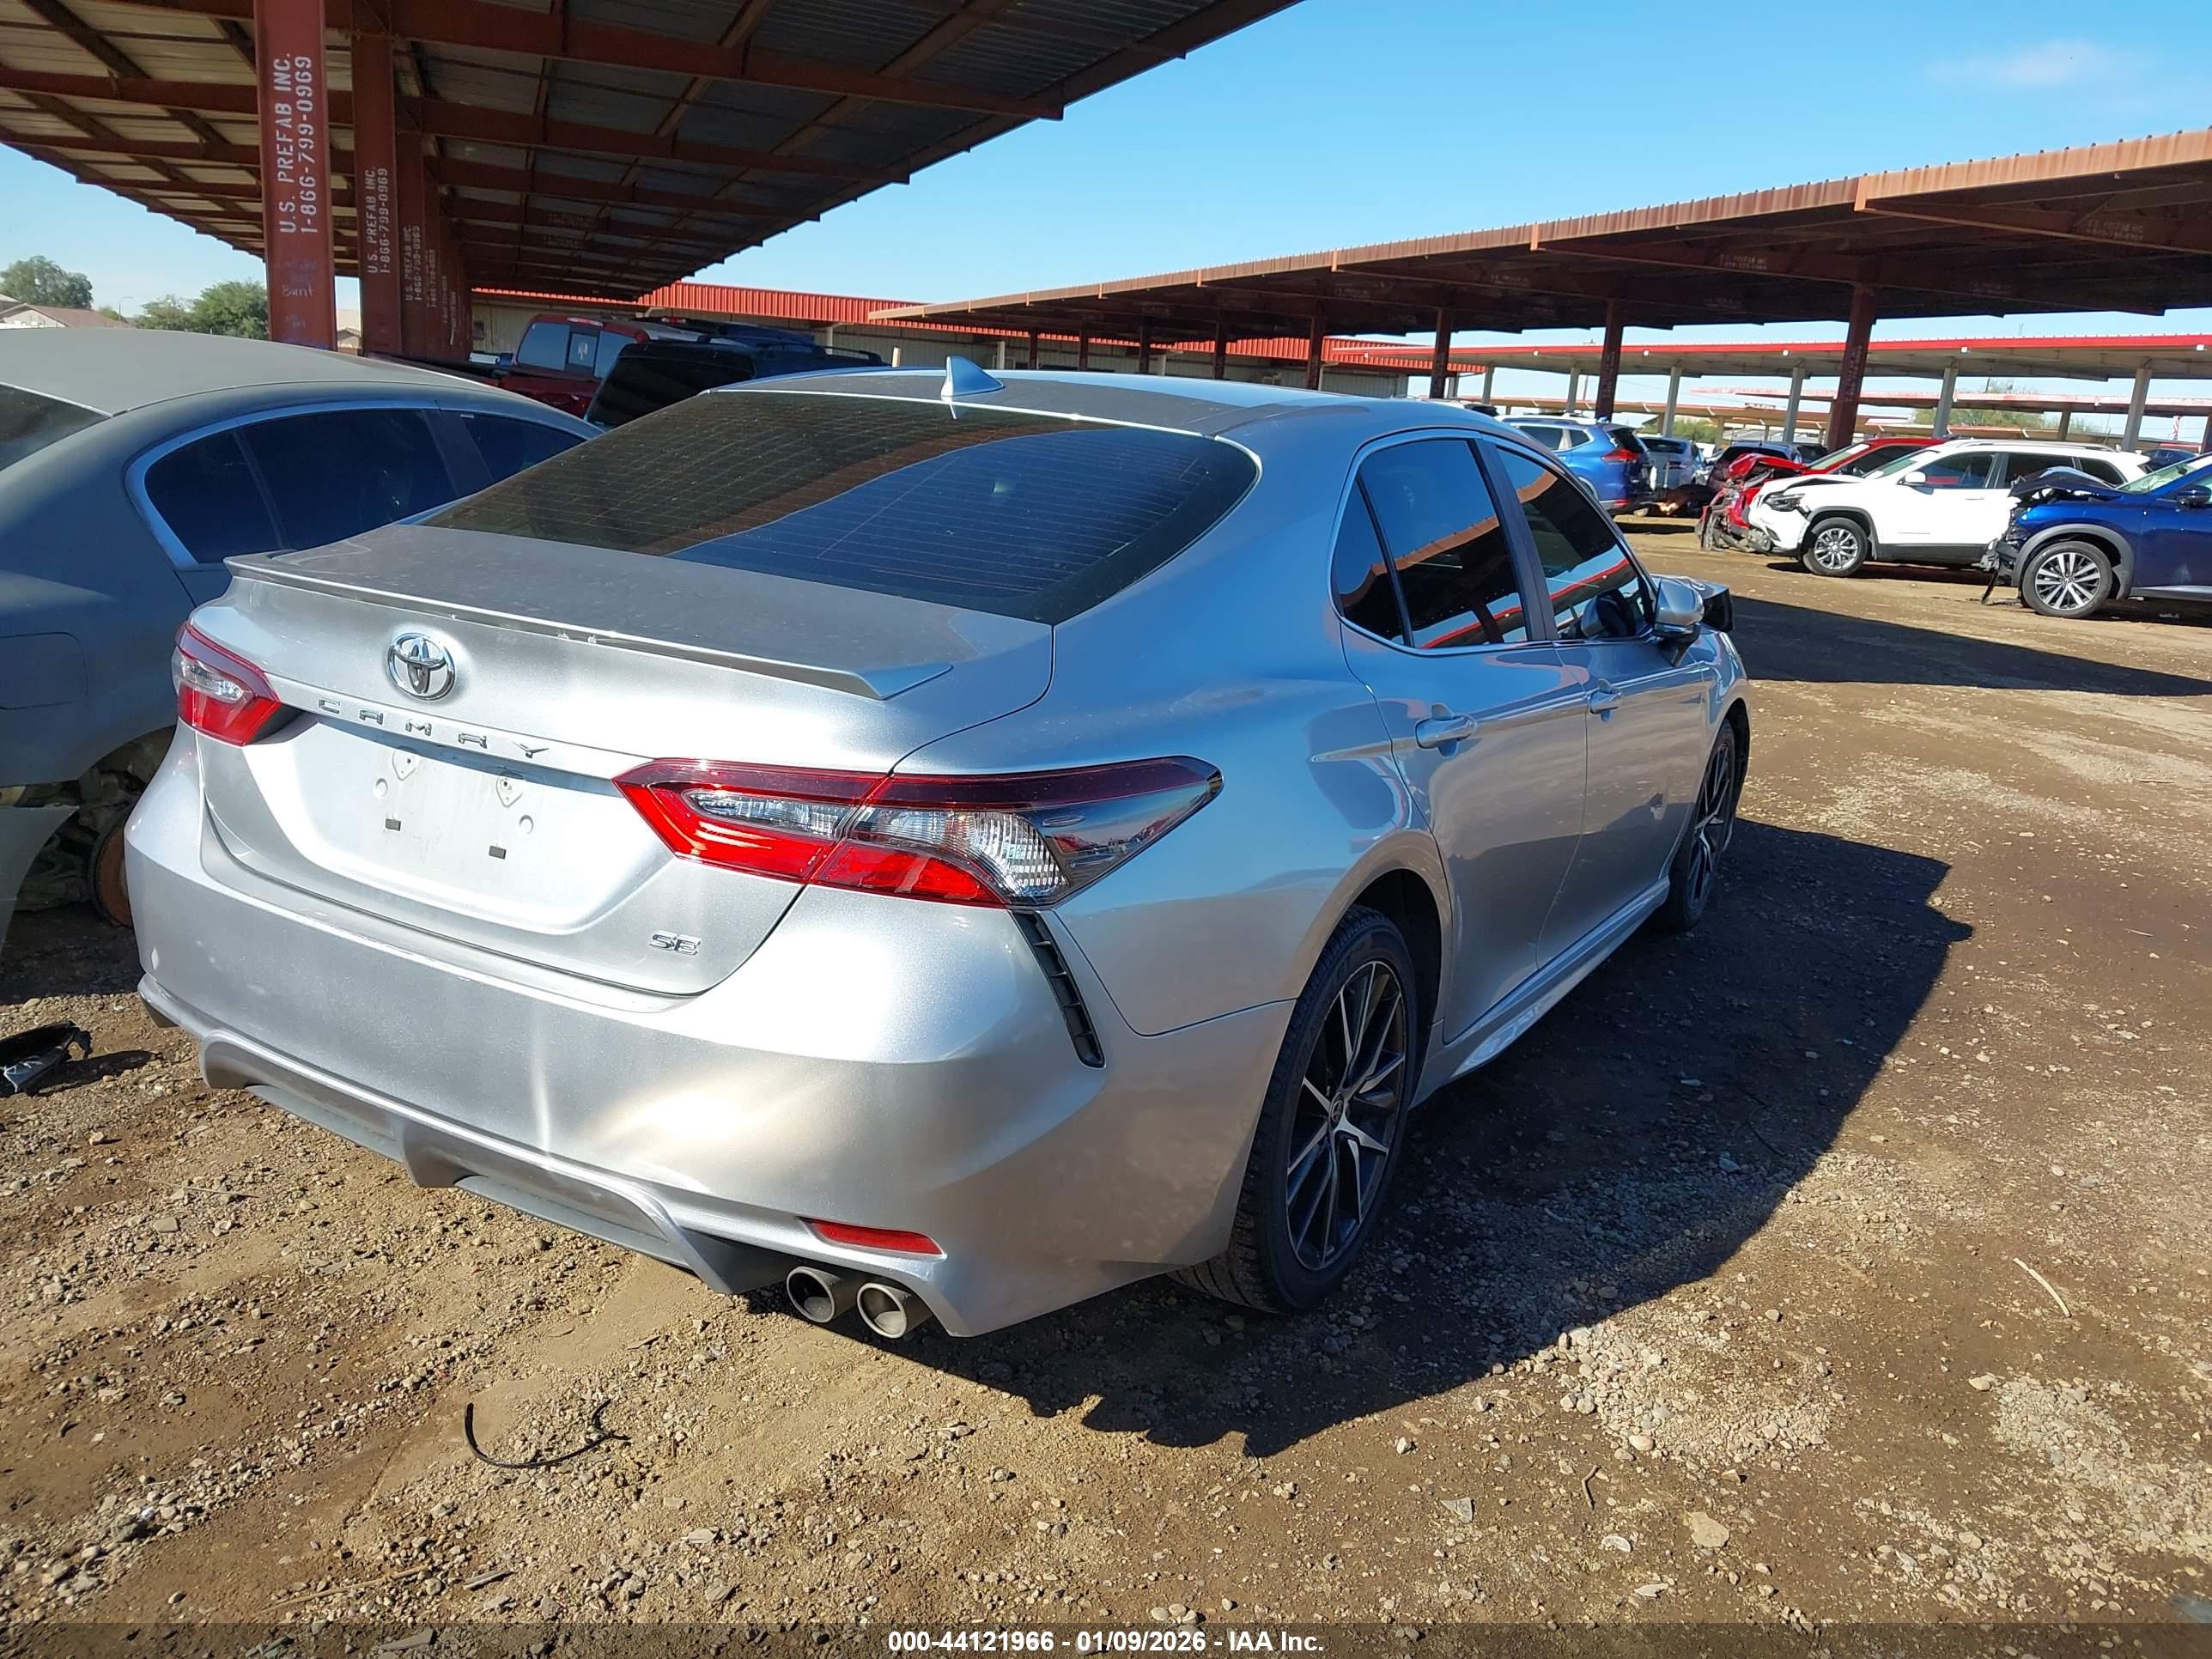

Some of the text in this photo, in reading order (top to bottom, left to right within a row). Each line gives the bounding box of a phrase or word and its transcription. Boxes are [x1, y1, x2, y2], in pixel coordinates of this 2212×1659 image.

[273, 53, 296, 234] U.S. PREFAB INC.
[295, 56, 318, 234] 1-866-799-0969
[365, 195, 377, 244] PREFAB
[377, 167, 391, 273] 1-866-799-0969
[319, 697, 550, 758] CAMRY
[649, 930, 701, 956] SE
